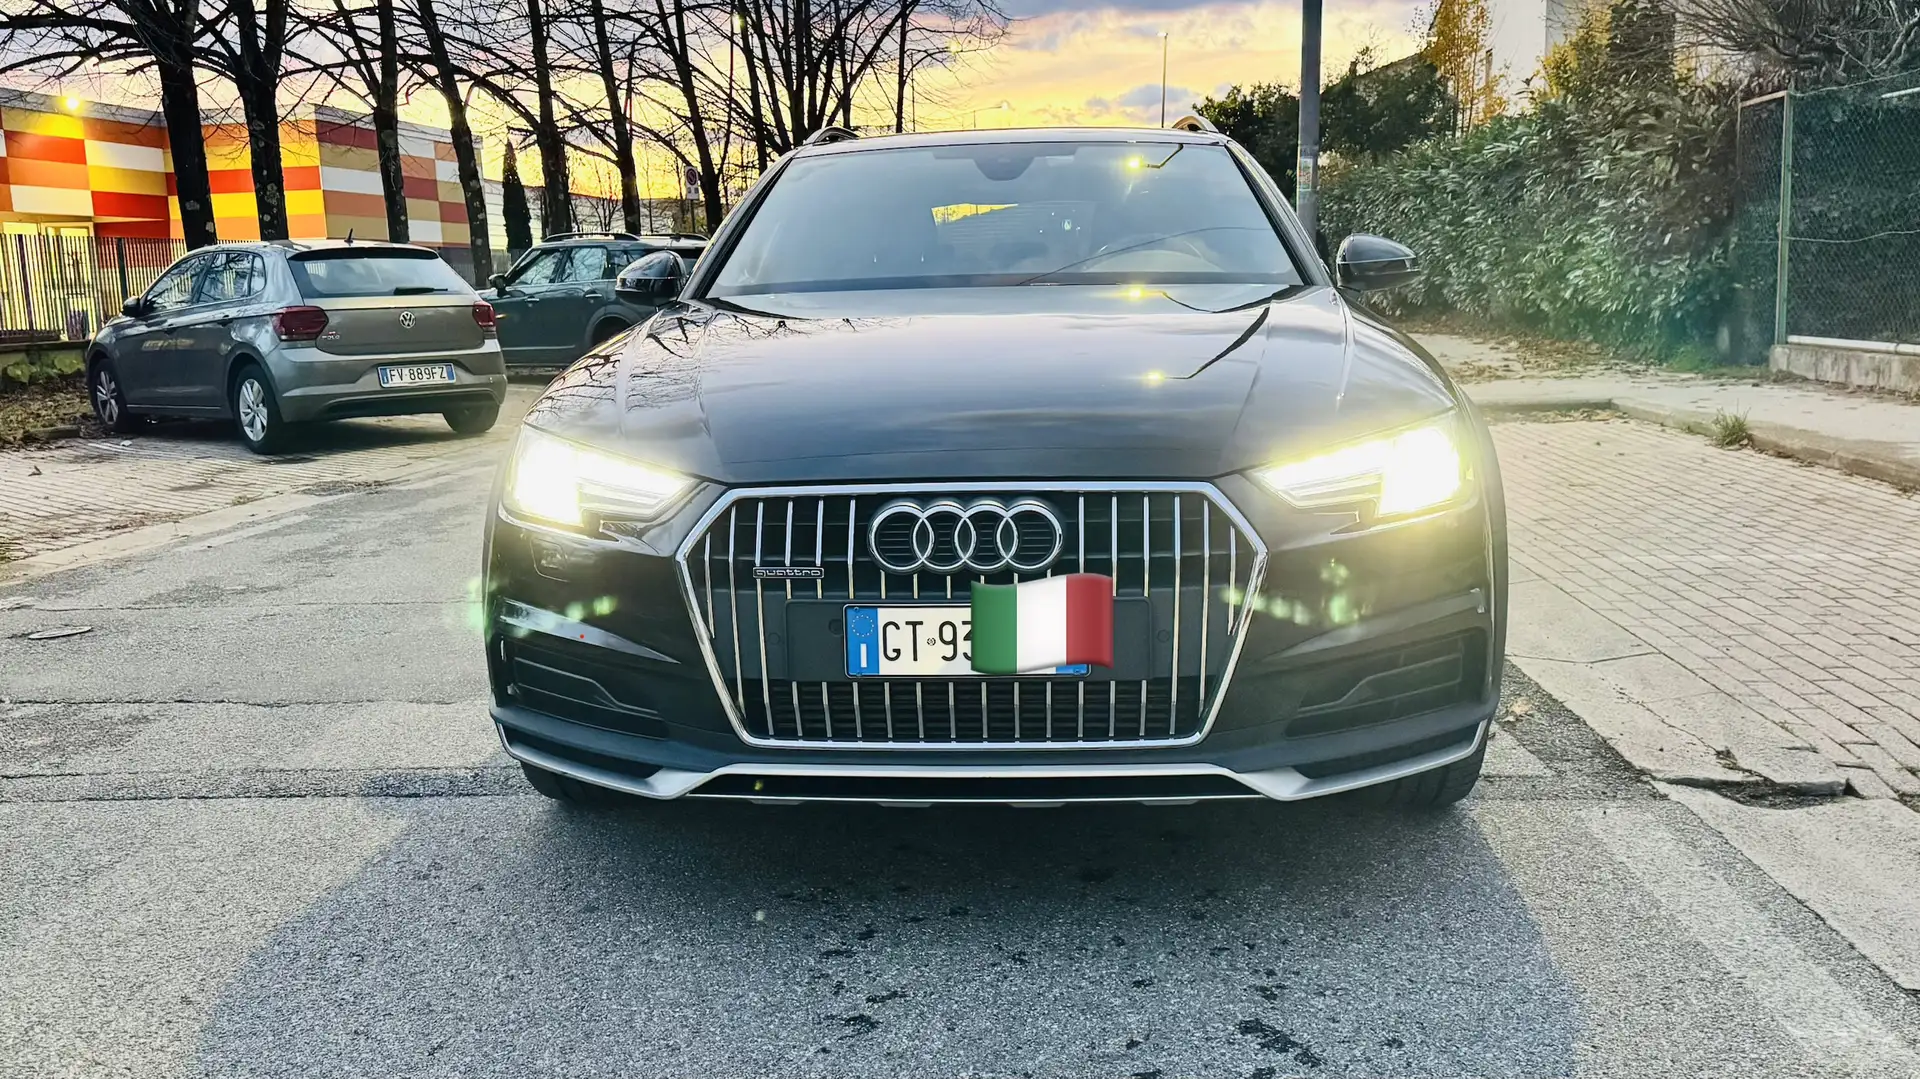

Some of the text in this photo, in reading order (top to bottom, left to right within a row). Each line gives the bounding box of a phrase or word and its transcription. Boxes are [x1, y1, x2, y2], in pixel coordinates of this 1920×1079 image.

[389, 368, 403, 382] FV
[408, 366, 446, 381] 889FZ
[756, 569, 820, 578] quattro
[860, 643, 868, 668] I
[882, 621, 924, 662] GT
